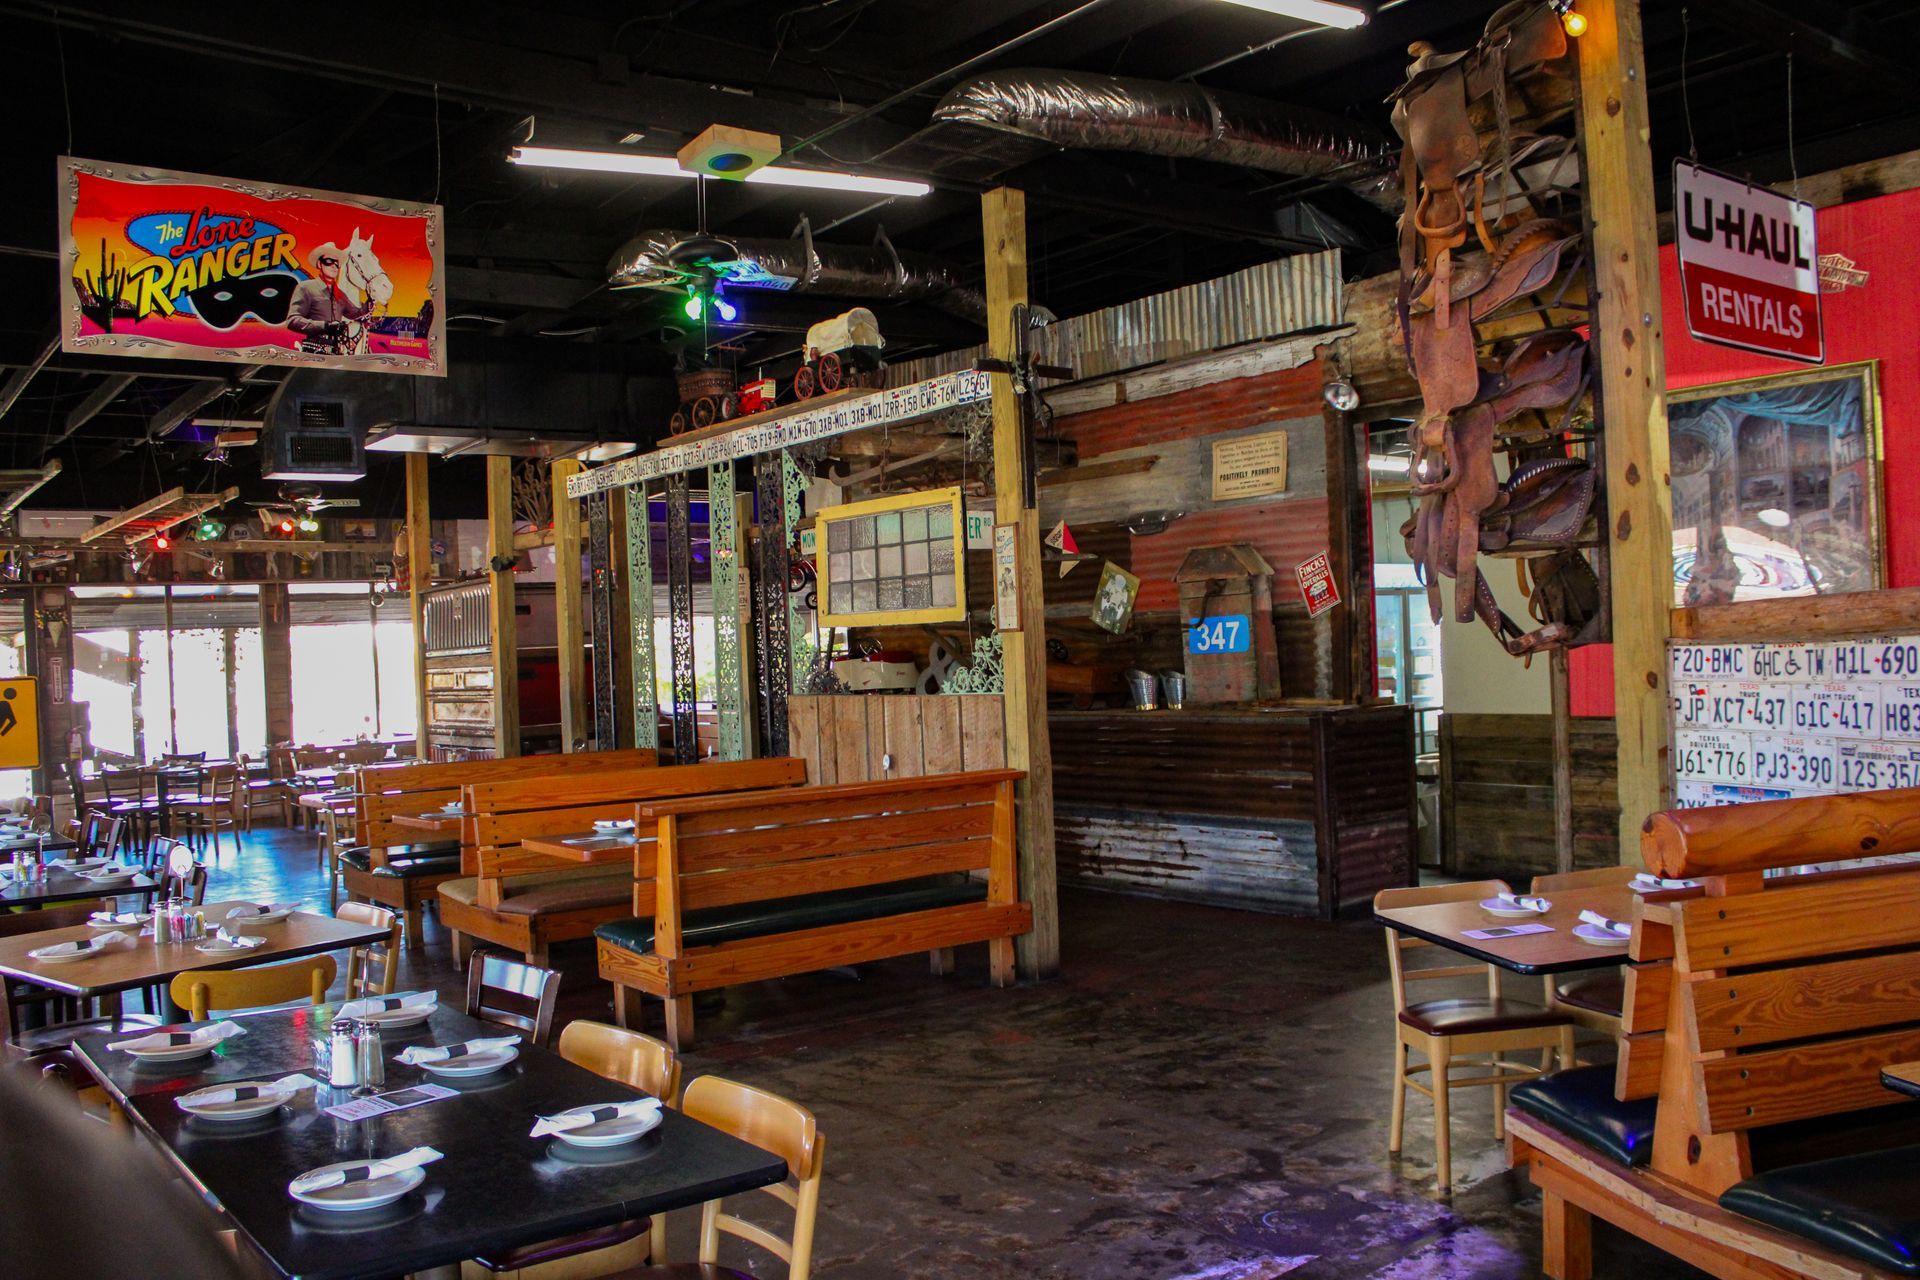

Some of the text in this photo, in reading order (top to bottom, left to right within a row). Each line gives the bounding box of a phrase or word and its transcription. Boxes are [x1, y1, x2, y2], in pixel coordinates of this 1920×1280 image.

[155, 206, 256, 257] The Lone
[1684, 190, 1810, 270] U-HAUL
[129, 233, 301, 318] RANGER
[1700, 282, 1804, 339] RENTALS
[1219, 470, 1249, 482] POSITIVELY
[1251, 465, 1281, 477] PROHIBITED
[1197, 621, 1240, 651] 347
[1823, 684, 1847, 692] TEXAS
[1783, 738, 1804, 746] TEXAS
[1871, 745, 1895, 753] TEXAS
